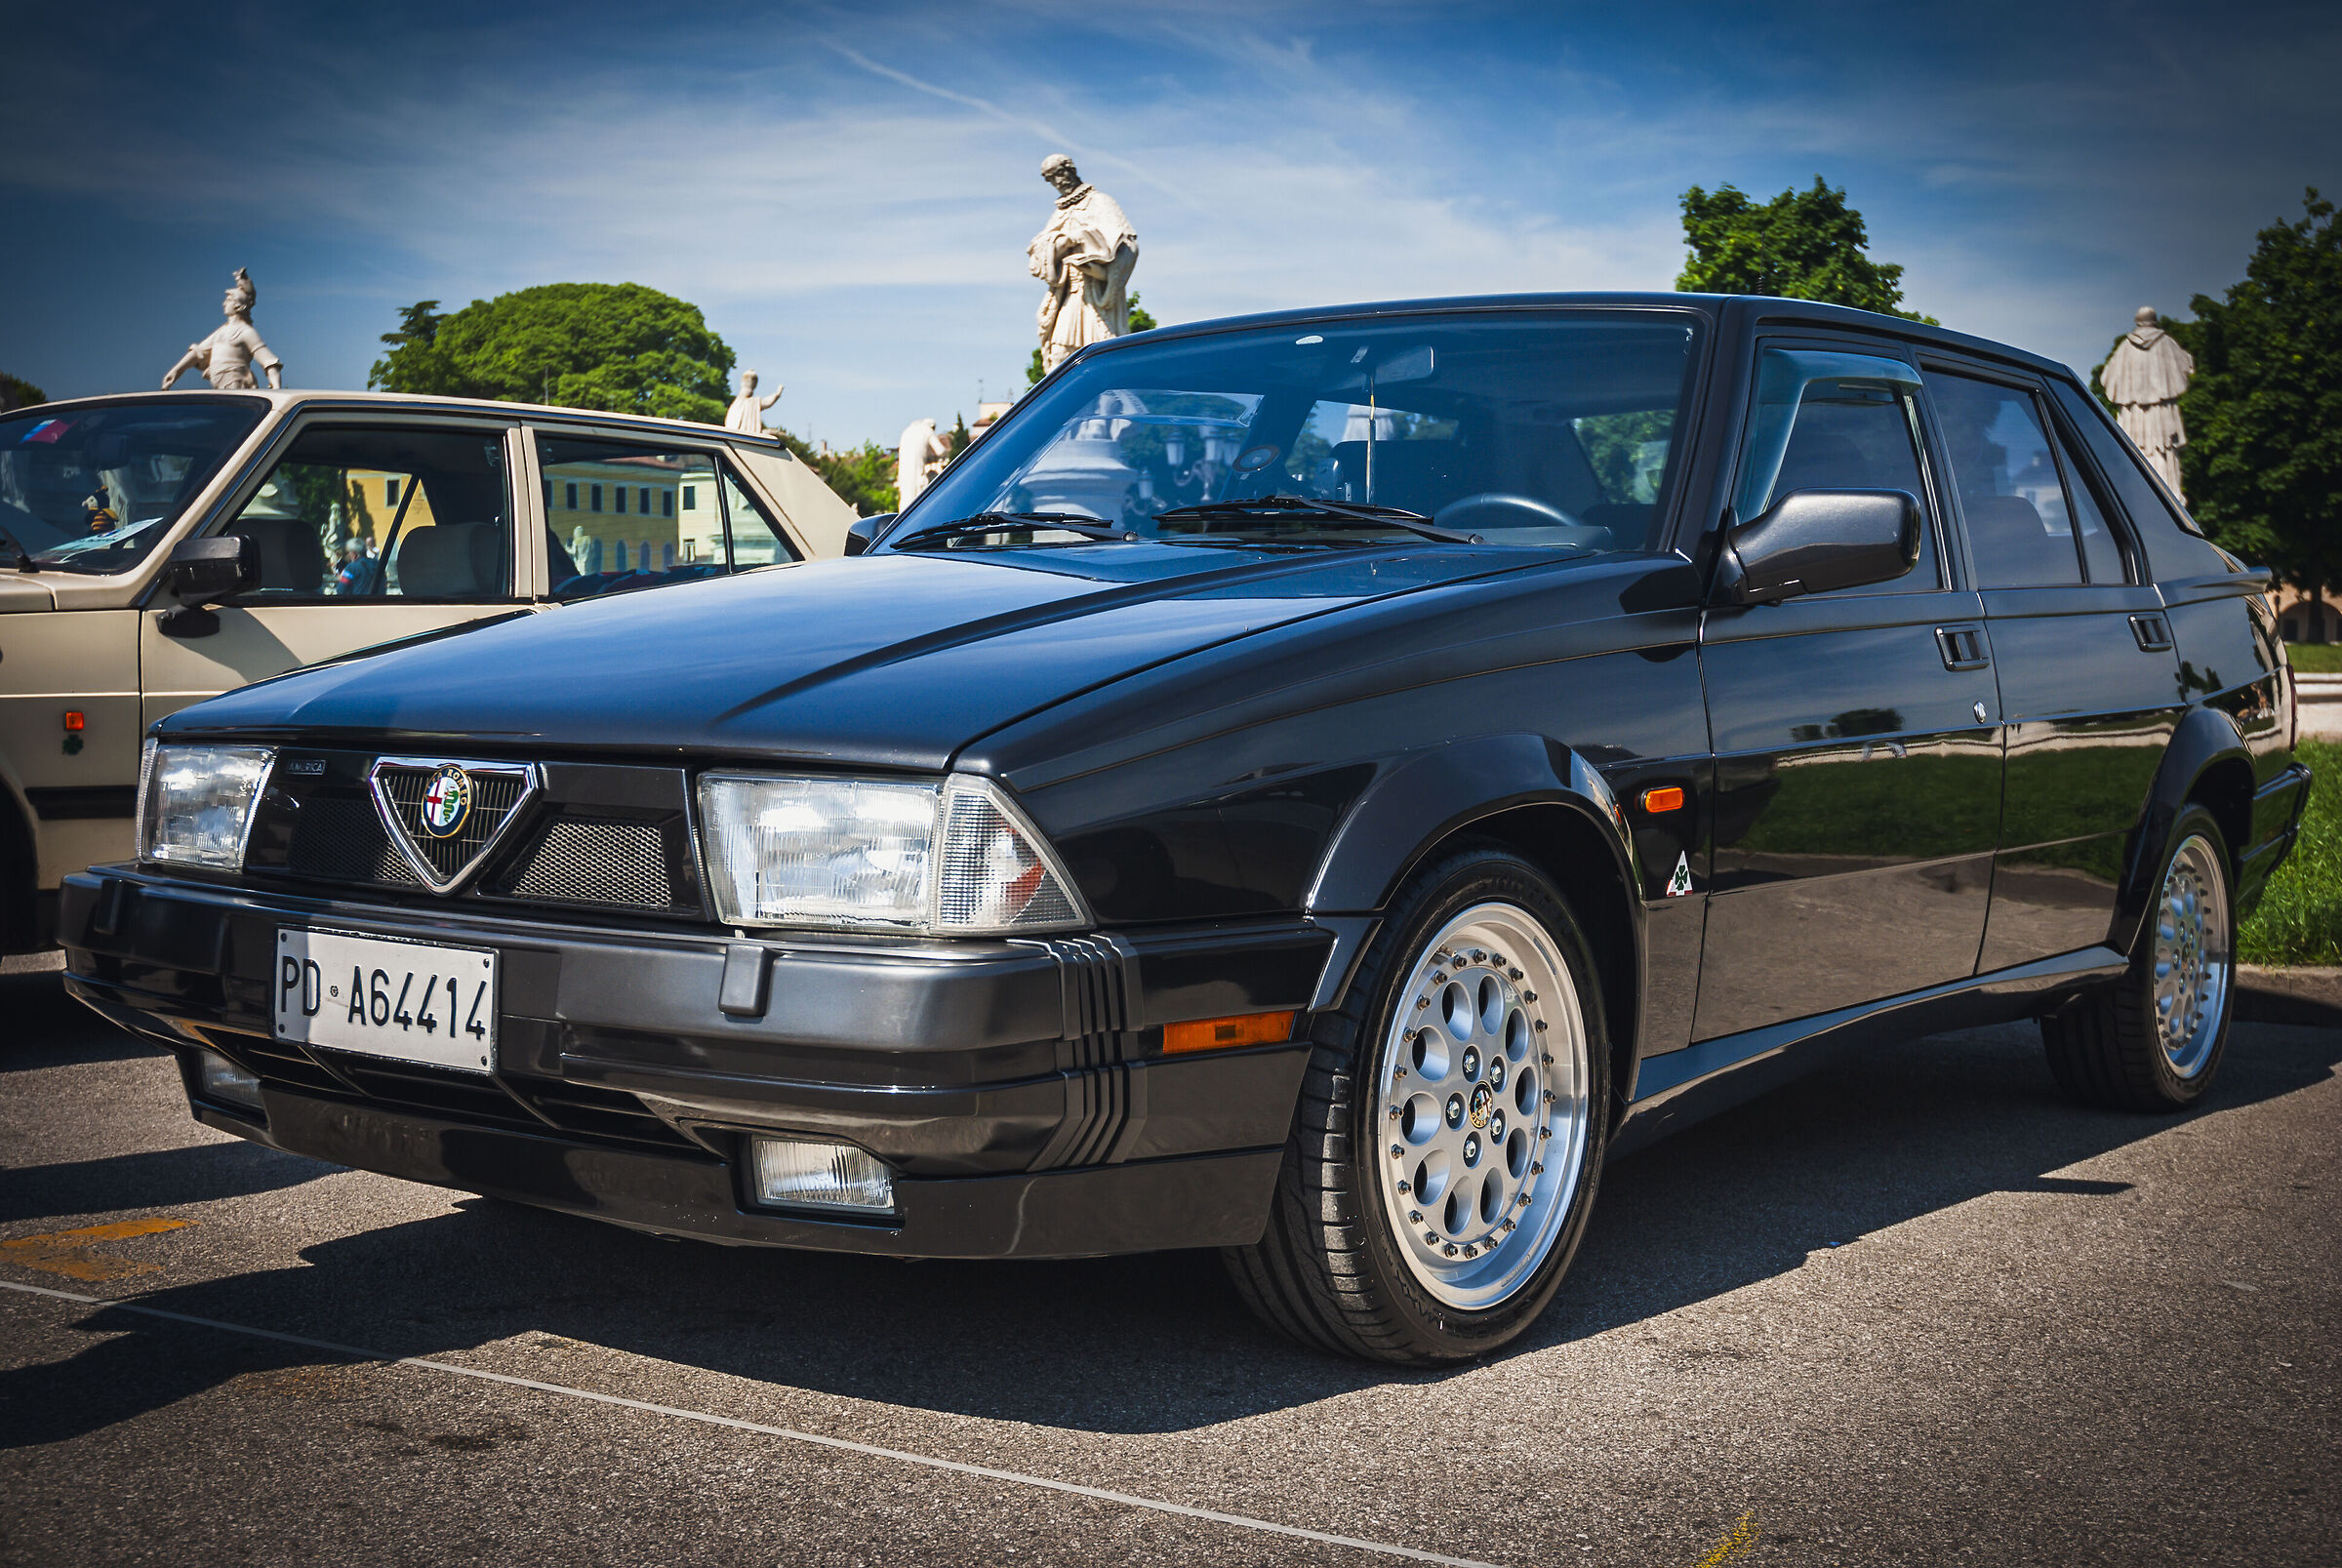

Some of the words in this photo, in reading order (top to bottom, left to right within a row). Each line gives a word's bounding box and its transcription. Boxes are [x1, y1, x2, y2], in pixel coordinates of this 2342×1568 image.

[447, 768, 467, 806] ROMEO
[280, 955, 321, 1017] PD
[347, 965, 487, 1040] A64414
